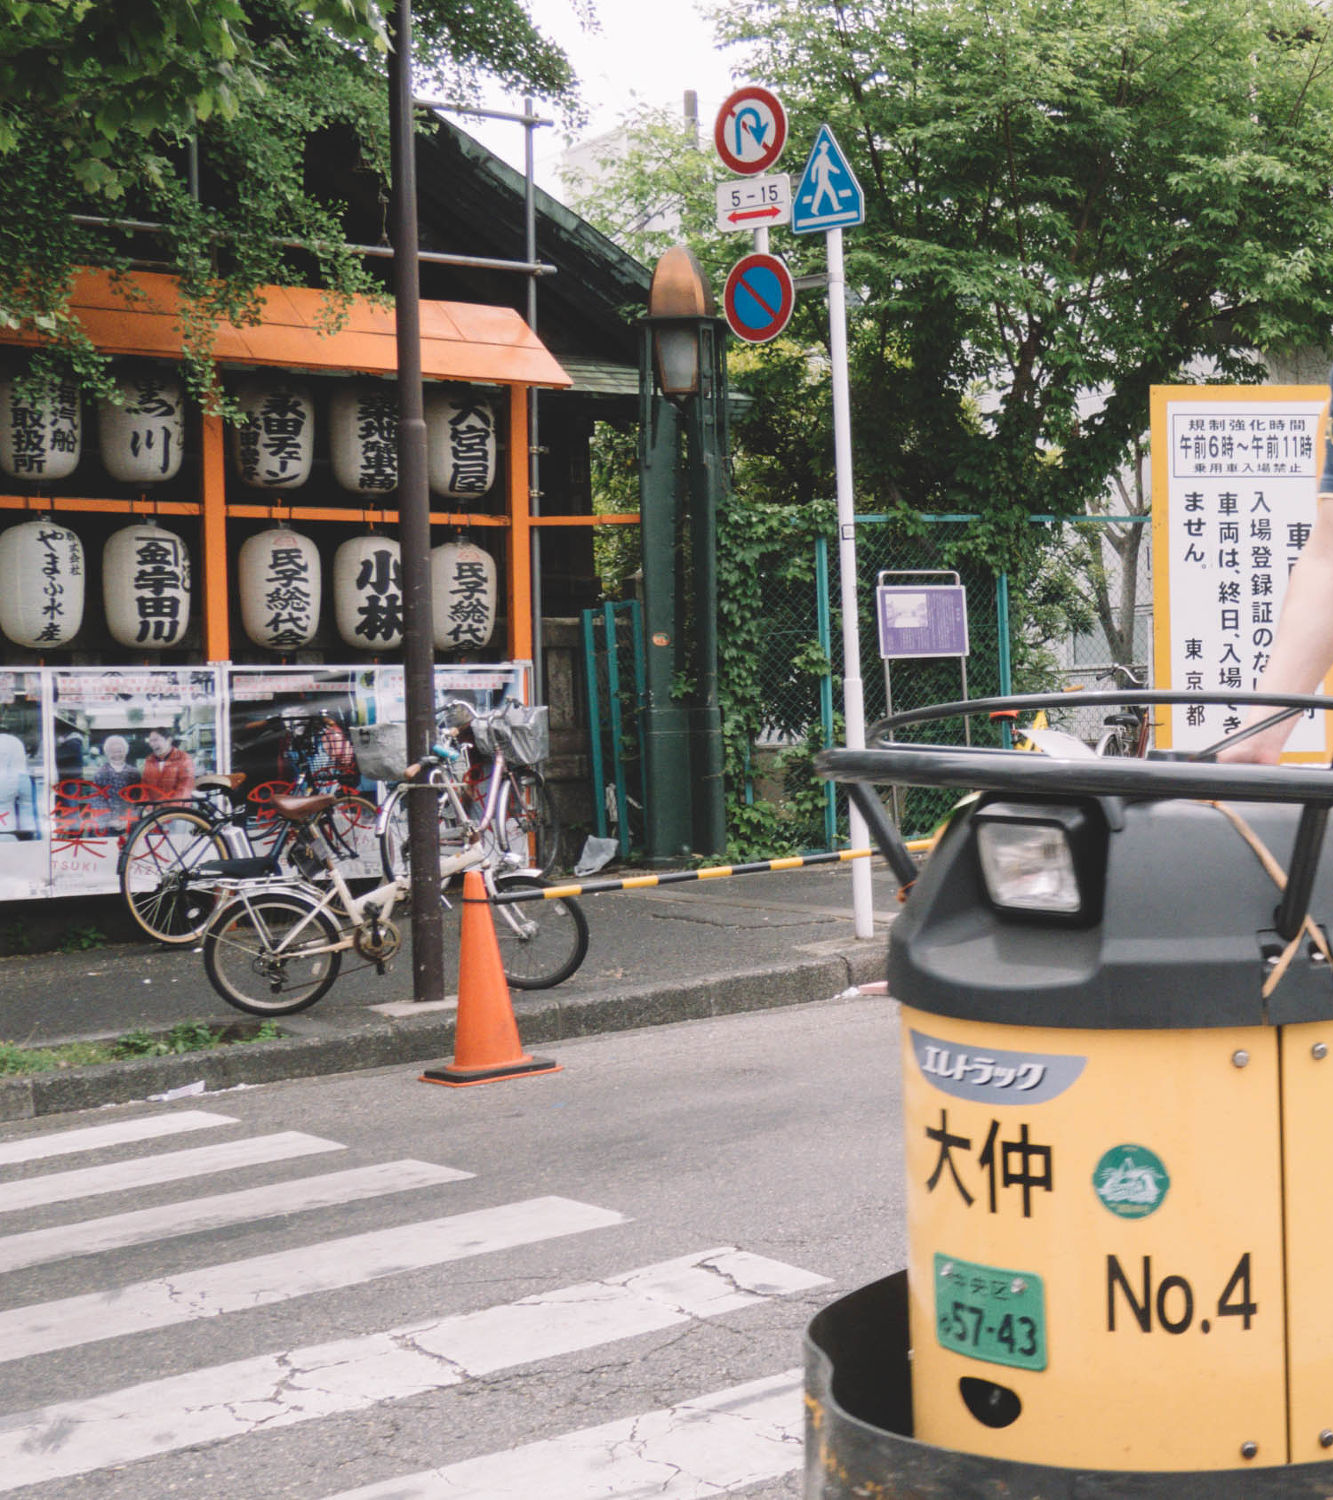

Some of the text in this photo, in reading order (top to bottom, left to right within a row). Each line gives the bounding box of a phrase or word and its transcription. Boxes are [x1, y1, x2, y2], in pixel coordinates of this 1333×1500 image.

[731, 184, 778, 207] 5-15
[449, 399, 490, 492] 大宮屋
[1188, 419, 1306, 432] 規制強化時間
[1194, 462, 1303, 474] 乗用車入場禁止
[1183, 491, 1207, 569] ません。
[265, 548, 310, 646] 氏子総代会
[356, 550, 402, 641] 小林
[1185, 638, 1205, 727] 東京都
[922, 1046, 1046, 1091] エルトラック
[925, 1108, 1054, 1218] 大仲
[951, 1301, 1036, 1356] 57-43
[1106, 1252, 1258, 1335] No.4
